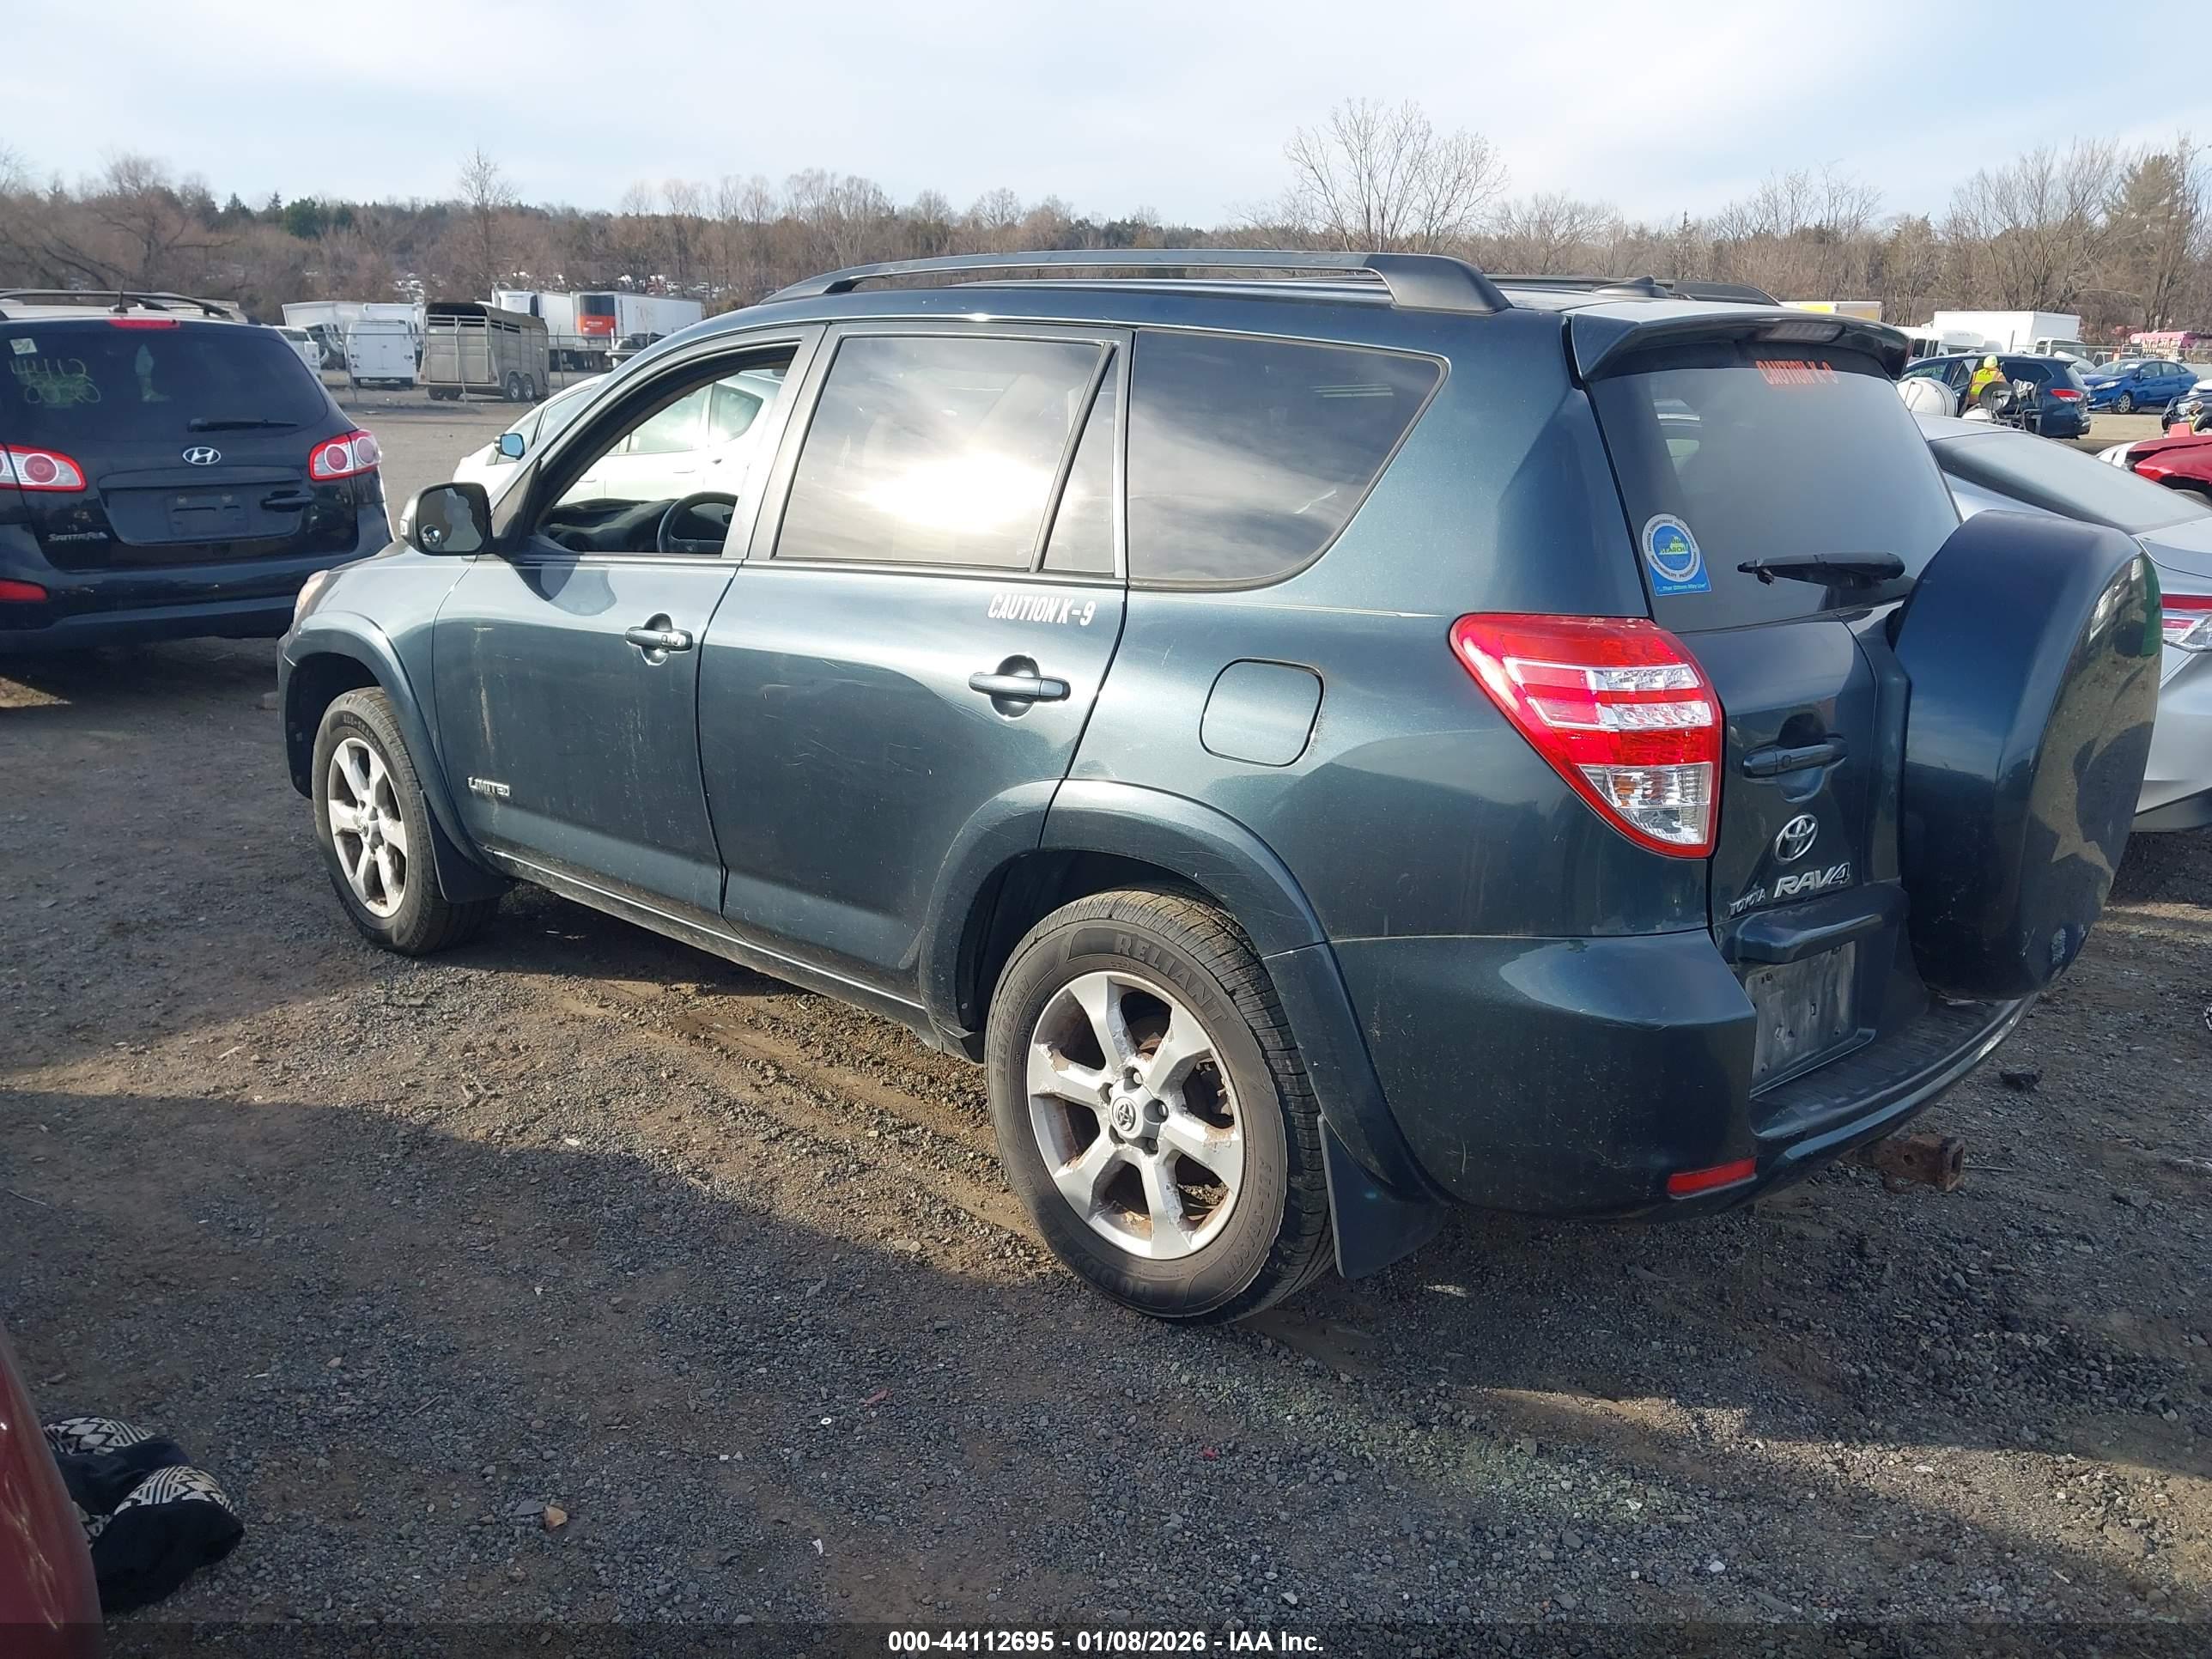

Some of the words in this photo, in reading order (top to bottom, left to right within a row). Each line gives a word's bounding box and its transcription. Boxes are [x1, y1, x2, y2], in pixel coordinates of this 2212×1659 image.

[1755, 360, 1815, 385] CAUTION
[1807, 360, 1839, 385] K-9
[988, 592, 1060, 623] CAUTION
[1056, 598, 1097, 626] K-9
[1773, 862, 1850, 898] RAV4
[1729, 889, 1766, 916] TOYOTA
[1115, 933, 1229, 1024] RELIANT
